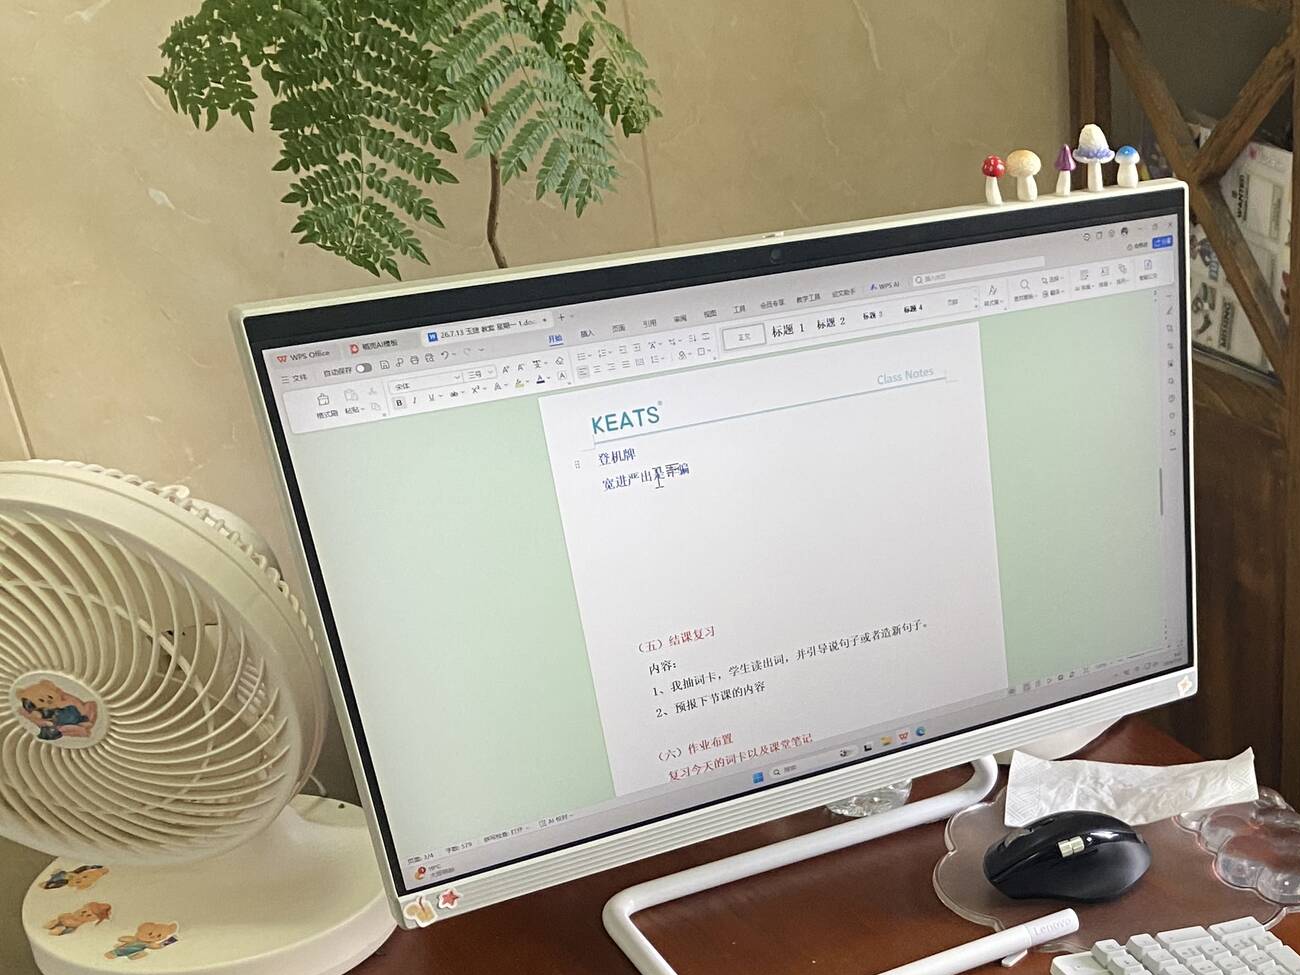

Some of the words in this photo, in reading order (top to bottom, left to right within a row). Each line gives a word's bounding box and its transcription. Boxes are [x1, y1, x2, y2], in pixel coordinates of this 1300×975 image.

[772, 324, 794, 338] 标题
[817, 317, 836, 330] 标题
[290, 353, 307, 361] WPS
[309, 350, 330, 359] Office
[877, 371, 902, 386] Class
[905, 367, 934, 381] Notes
[591, 406, 660, 435] KEATS
[598, 448, 636, 467] 登机牌
[668, 733, 813, 781] 复习今天的词卡以及课堂笔记
